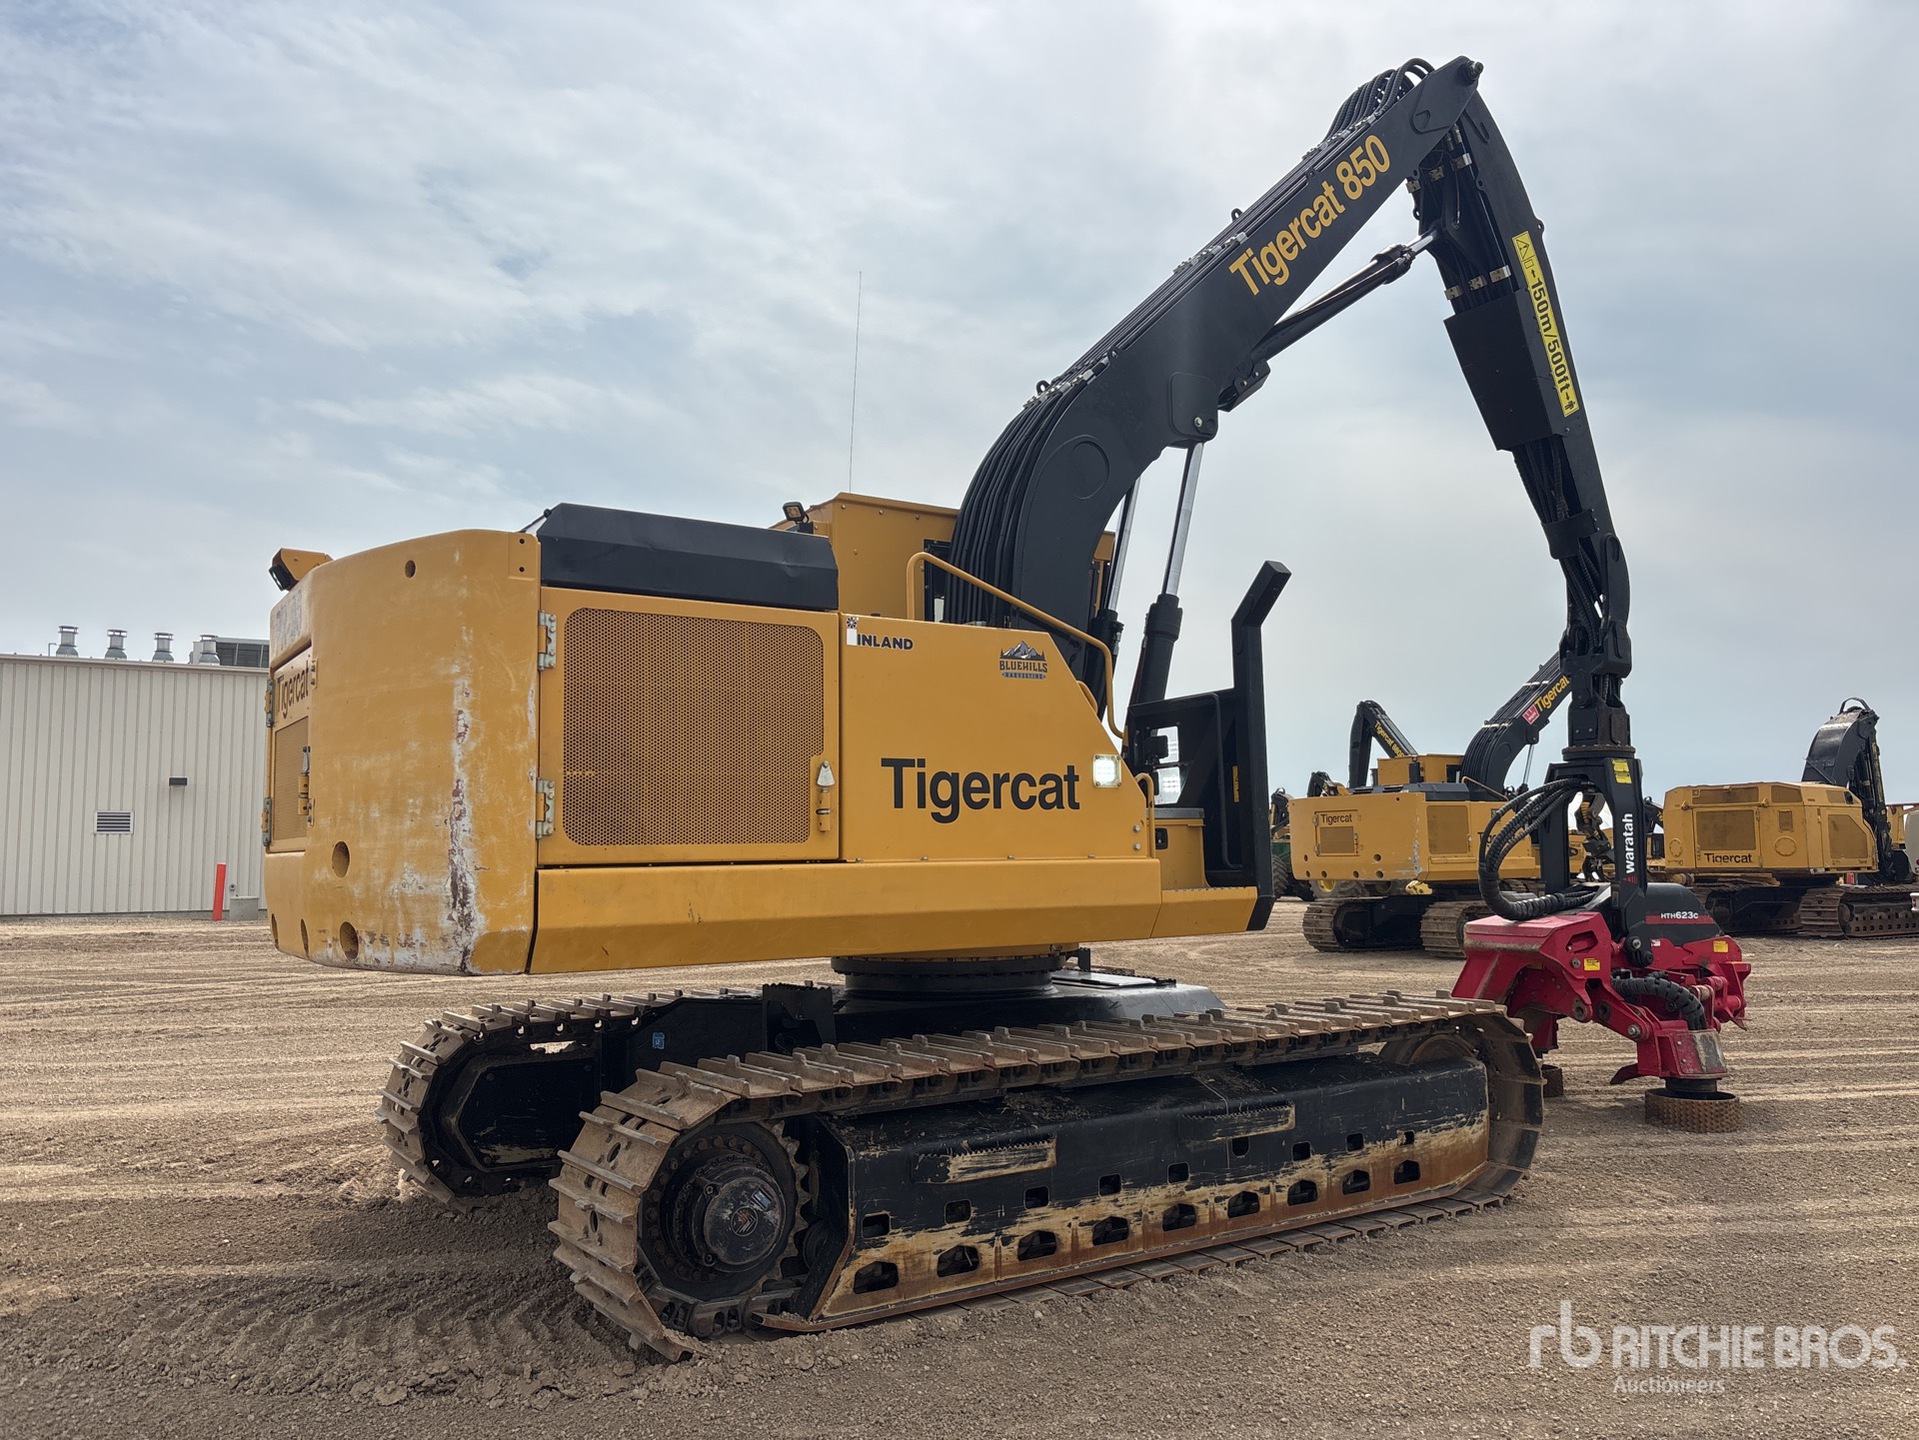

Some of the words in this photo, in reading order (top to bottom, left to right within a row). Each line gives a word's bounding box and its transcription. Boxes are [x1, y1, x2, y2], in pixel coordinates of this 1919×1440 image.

[1229, 182, 1346, 296] Tigercat
[1336, 134, 1391, 201] 850
[1531, 277, 1570, 394] 150m/500ft
[857, 634, 913, 650] INLAND
[999, 660, 1048, 673] BLUEHILLS
[276, 660, 309, 719] Tigercat
[1534, 675, 1570, 712] Tigercat
[1374, 720, 1396, 748] Tigercat
[881, 757, 1080, 824] Tigercat
[1320, 813, 1353, 825] Tigercat
[1622, 813, 1635, 874] waratah
[1704, 852, 1753, 865] Tigercat
